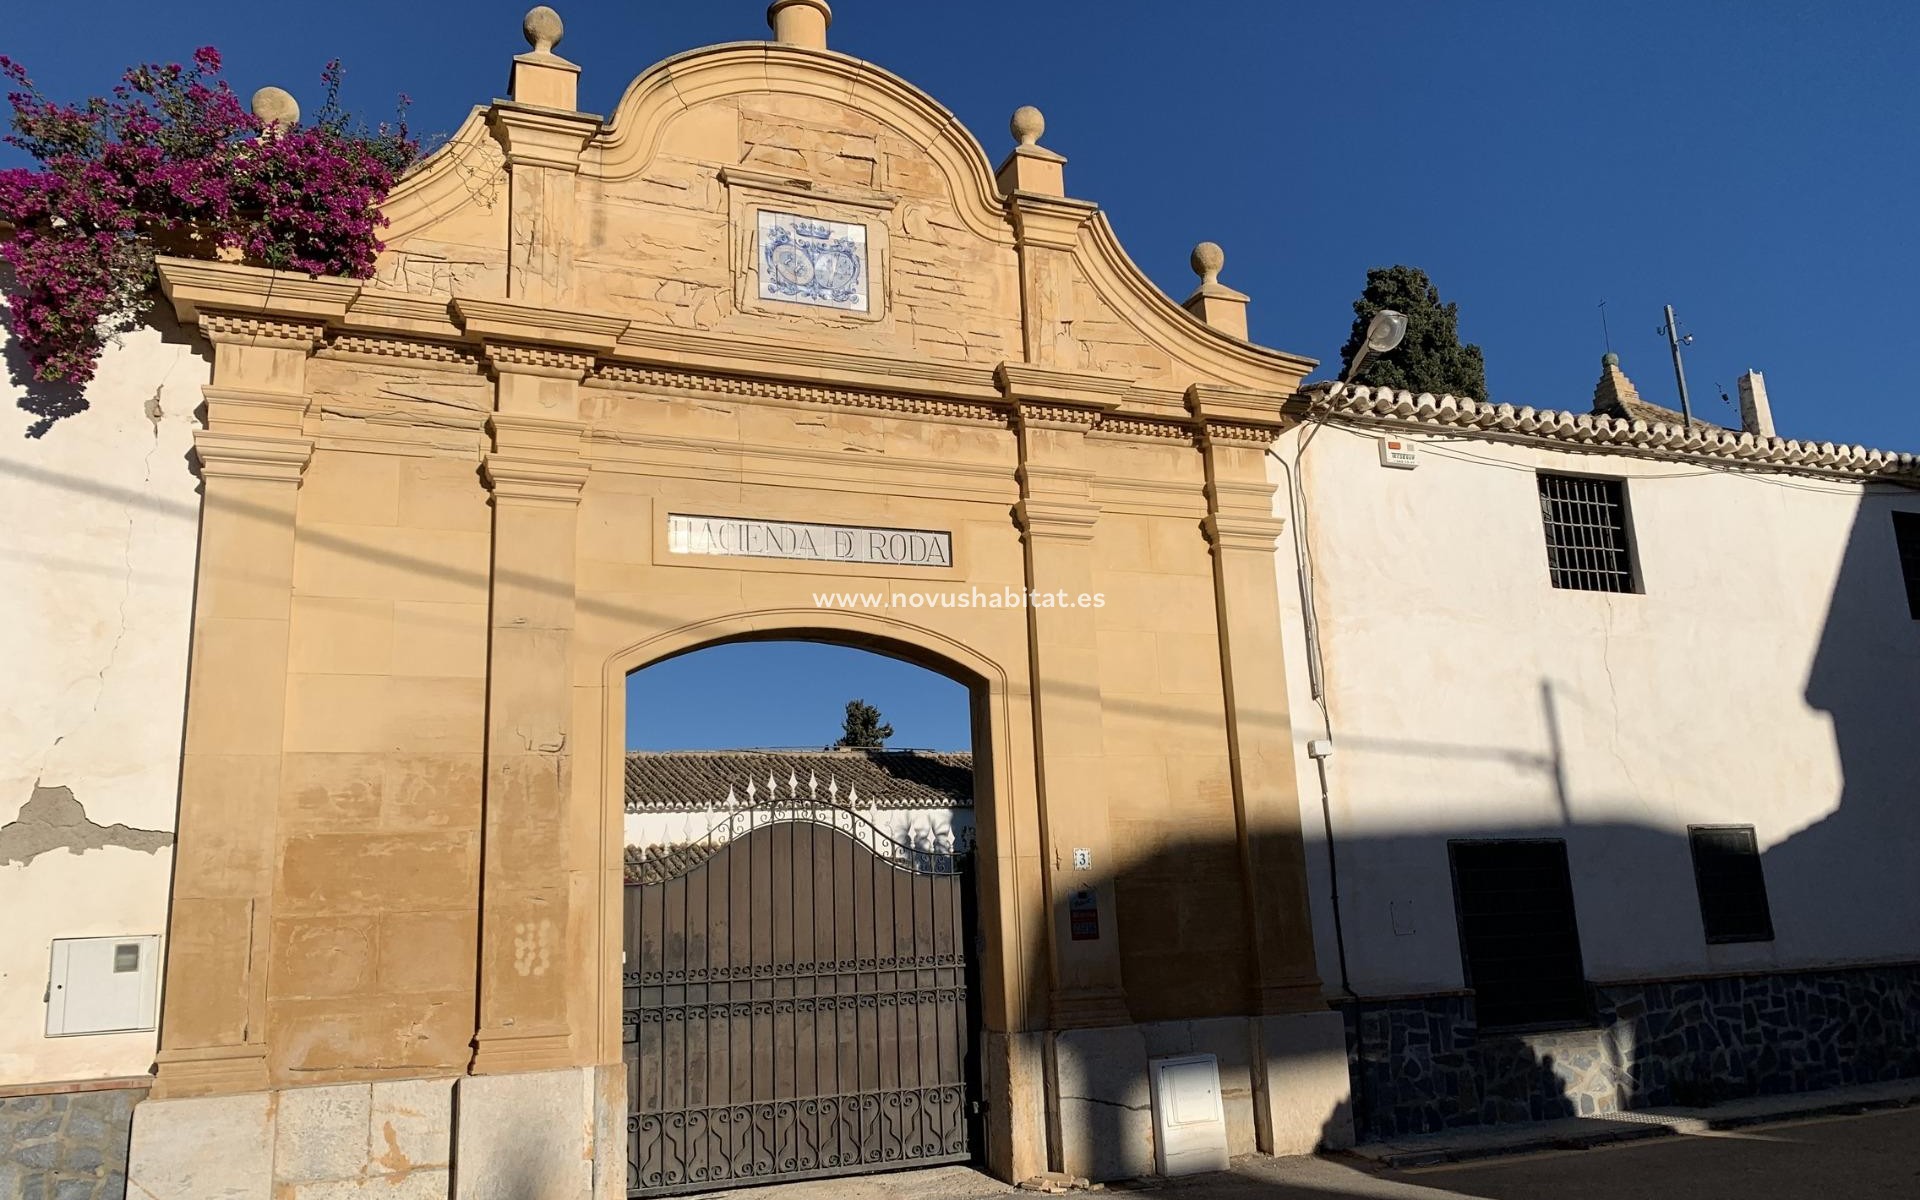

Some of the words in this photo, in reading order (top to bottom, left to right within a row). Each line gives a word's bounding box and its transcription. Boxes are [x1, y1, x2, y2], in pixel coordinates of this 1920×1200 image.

[674, 519, 819, 557] HACIENDA
[869, 532, 946, 563] RODA
[1079, 853, 1086, 866] 3
